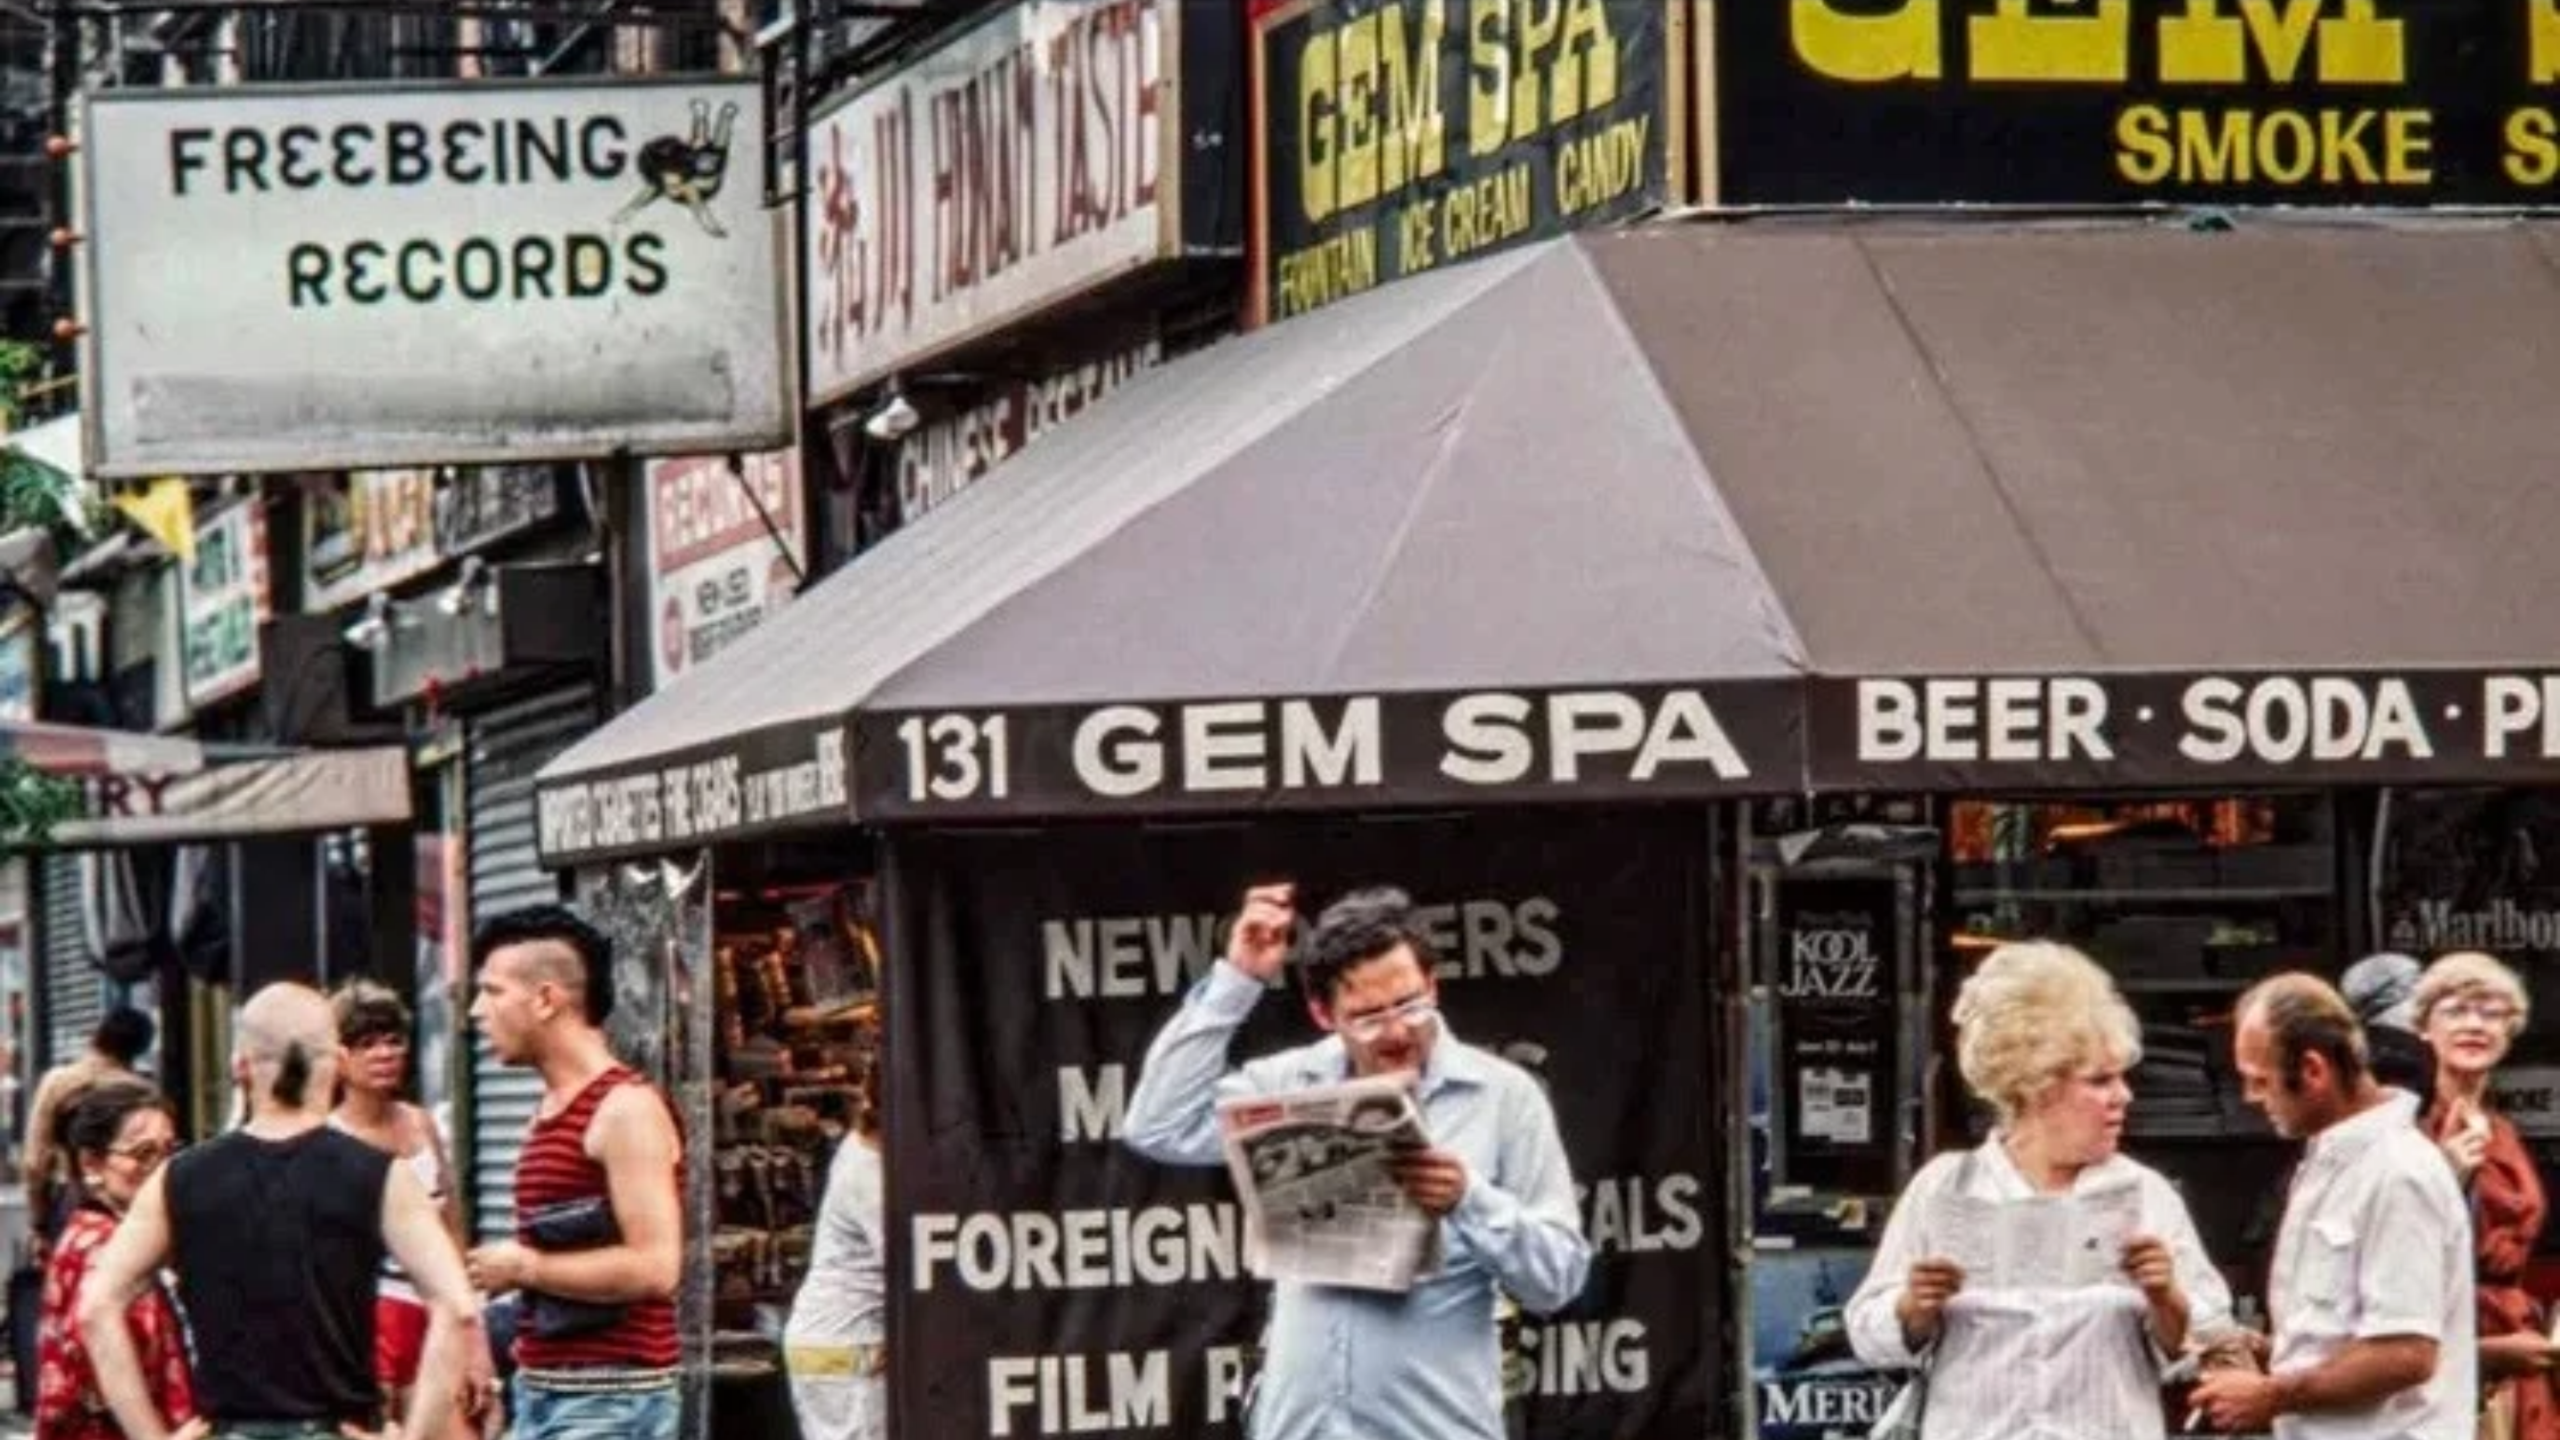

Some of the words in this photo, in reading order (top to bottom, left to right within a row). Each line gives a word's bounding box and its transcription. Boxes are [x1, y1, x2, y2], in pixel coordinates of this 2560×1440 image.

[1302, 0, 1446, 224] GEM
[1469, 0, 1617, 157] SPA
[2116, 105, 2432, 184] SMOKE
[170, 116, 628, 196] FREEBEING
[1402, 200, 1434, 274] ICE
[1443, 164, 1531, 257] CREAM
[1557, 115, 1650, 216] CANDY
[286, 232, 668, 306] RECORDS
[900, 715, 1005, 801] 131
[1073, 697, 1382, 797] GEM
[1440, 690, 1750, 783] SPA
[1857, 679, 2114, 761] BEER
[2178, 676, 2433, 762] SODA
[1779, 963, 1878, 997] JAZZ
[1792, 930, 1878, 963] KOOL
[912, 1203, 1239, 1293] FOREIGN
[988, 1350, 1170, 1438] FILM
